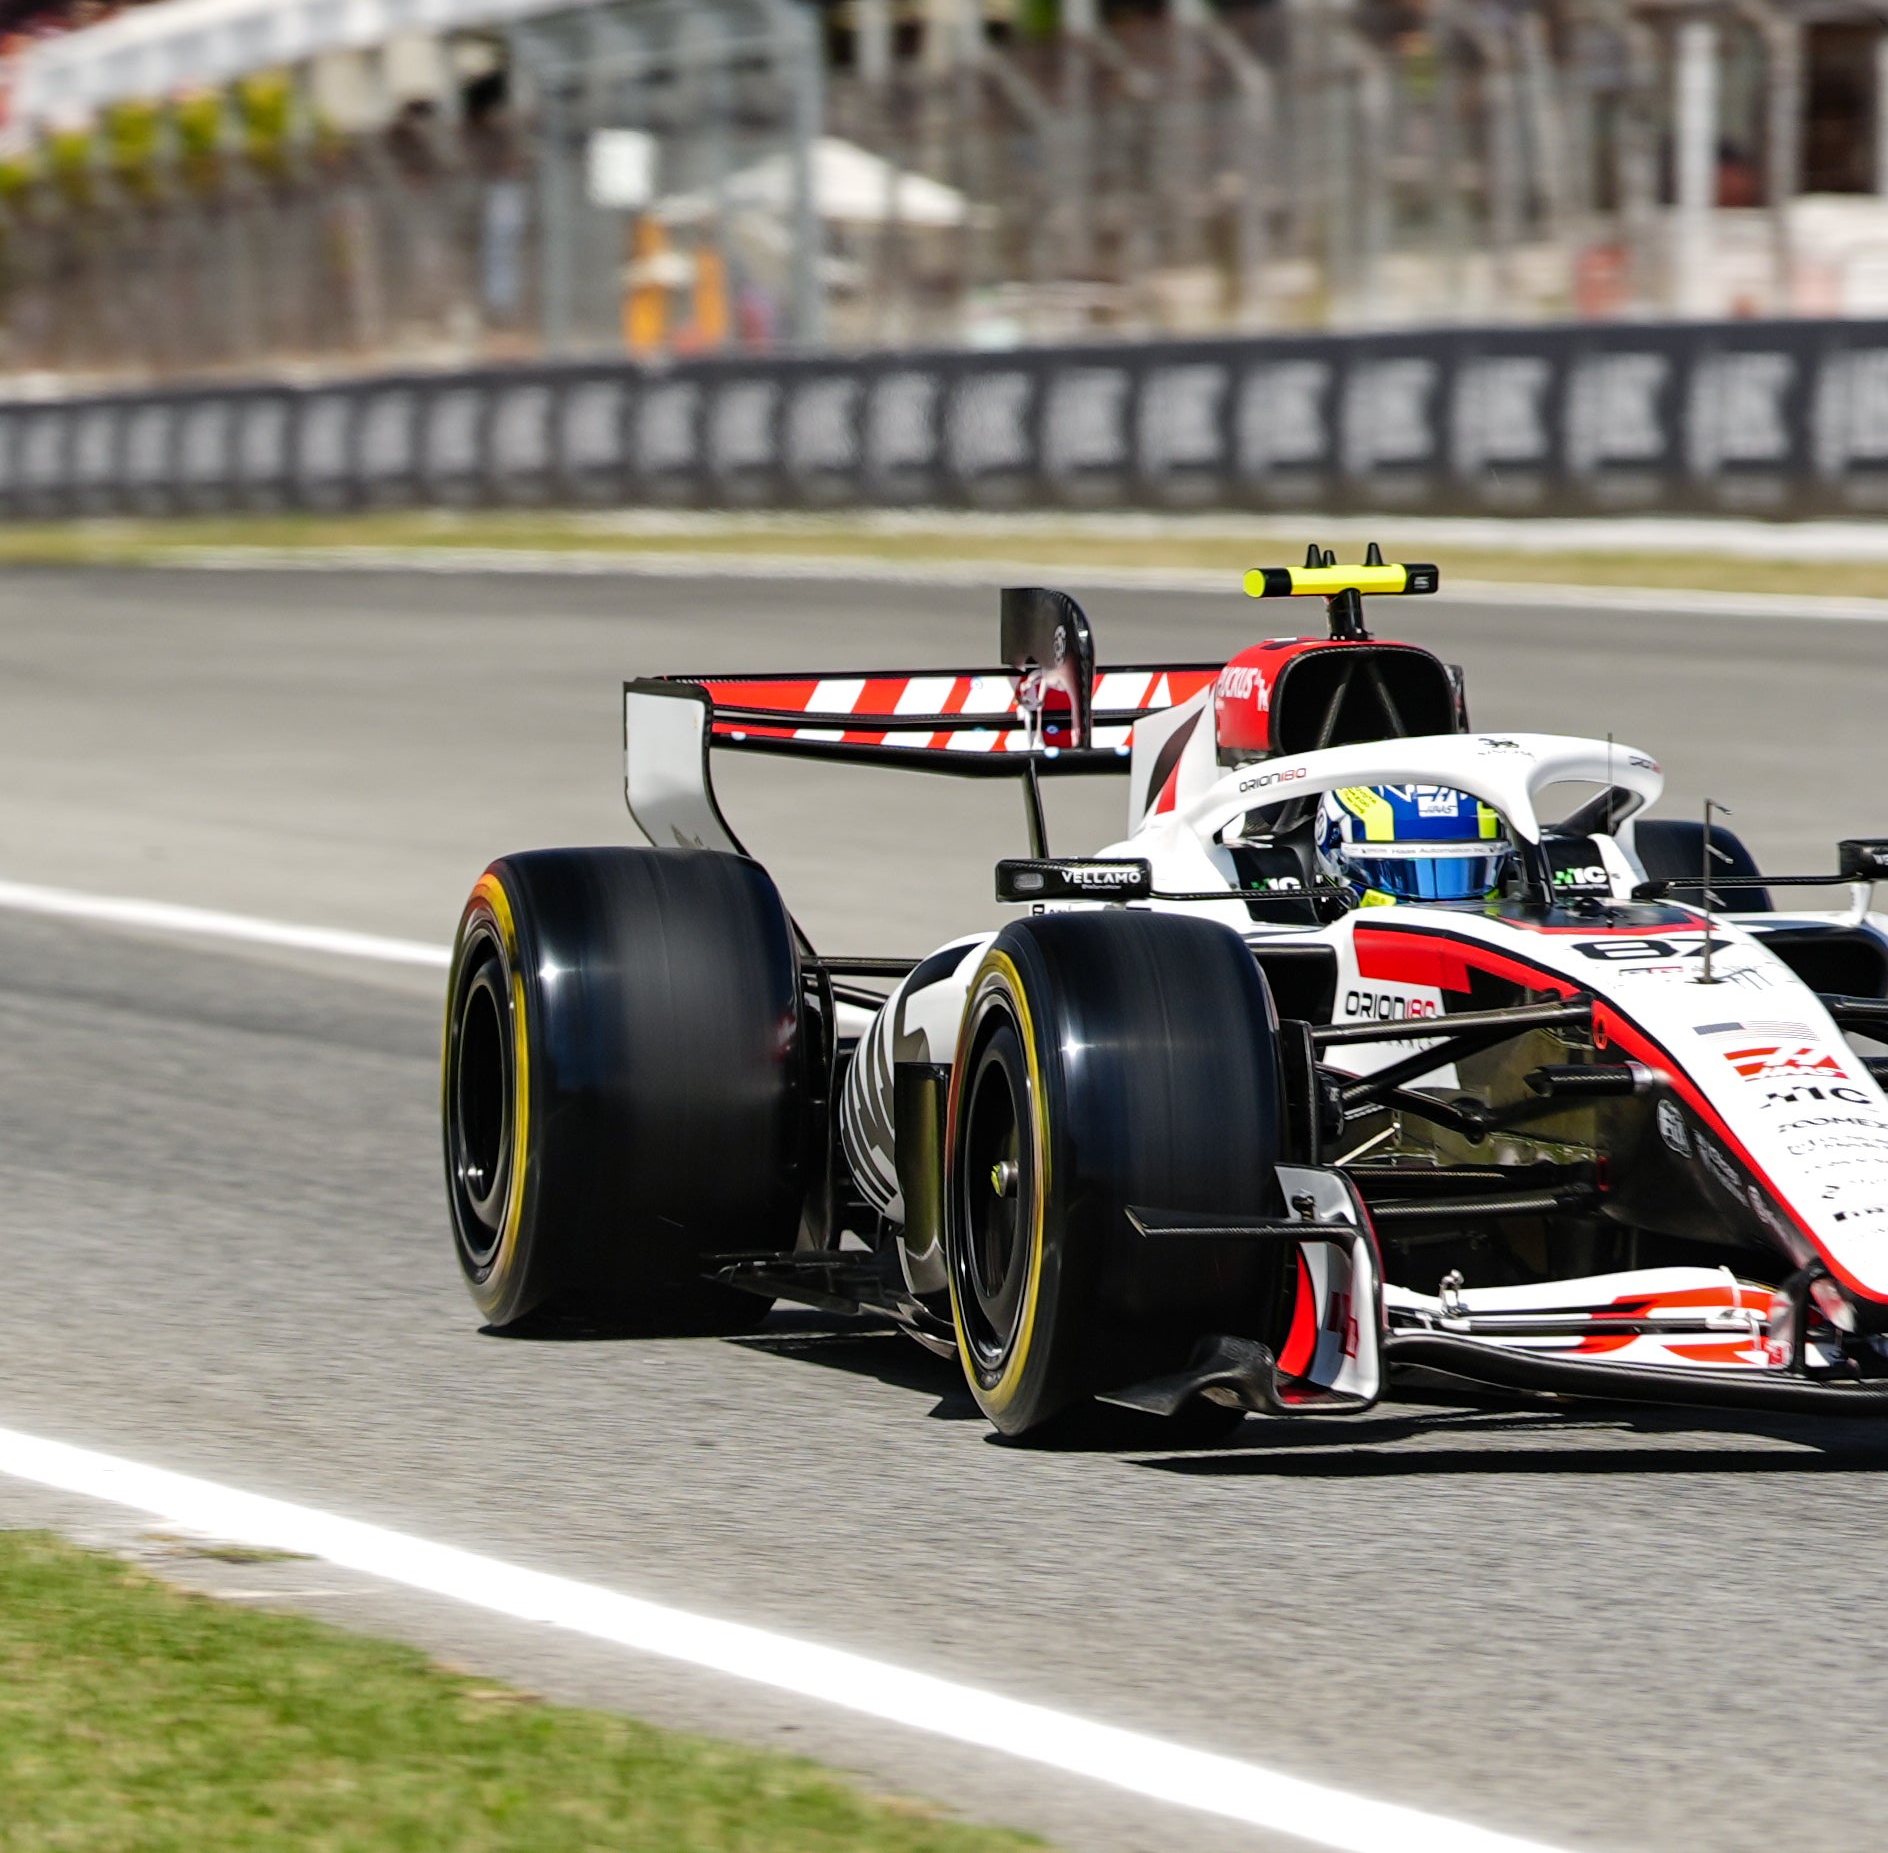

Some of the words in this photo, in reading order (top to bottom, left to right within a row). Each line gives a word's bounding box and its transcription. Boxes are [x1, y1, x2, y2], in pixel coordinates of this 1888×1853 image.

[1239, 768, 1307, 793] ORION180
[1062, 870, 1141, 883] VELLAMO
[1571, 938, 1735, 961] 87
